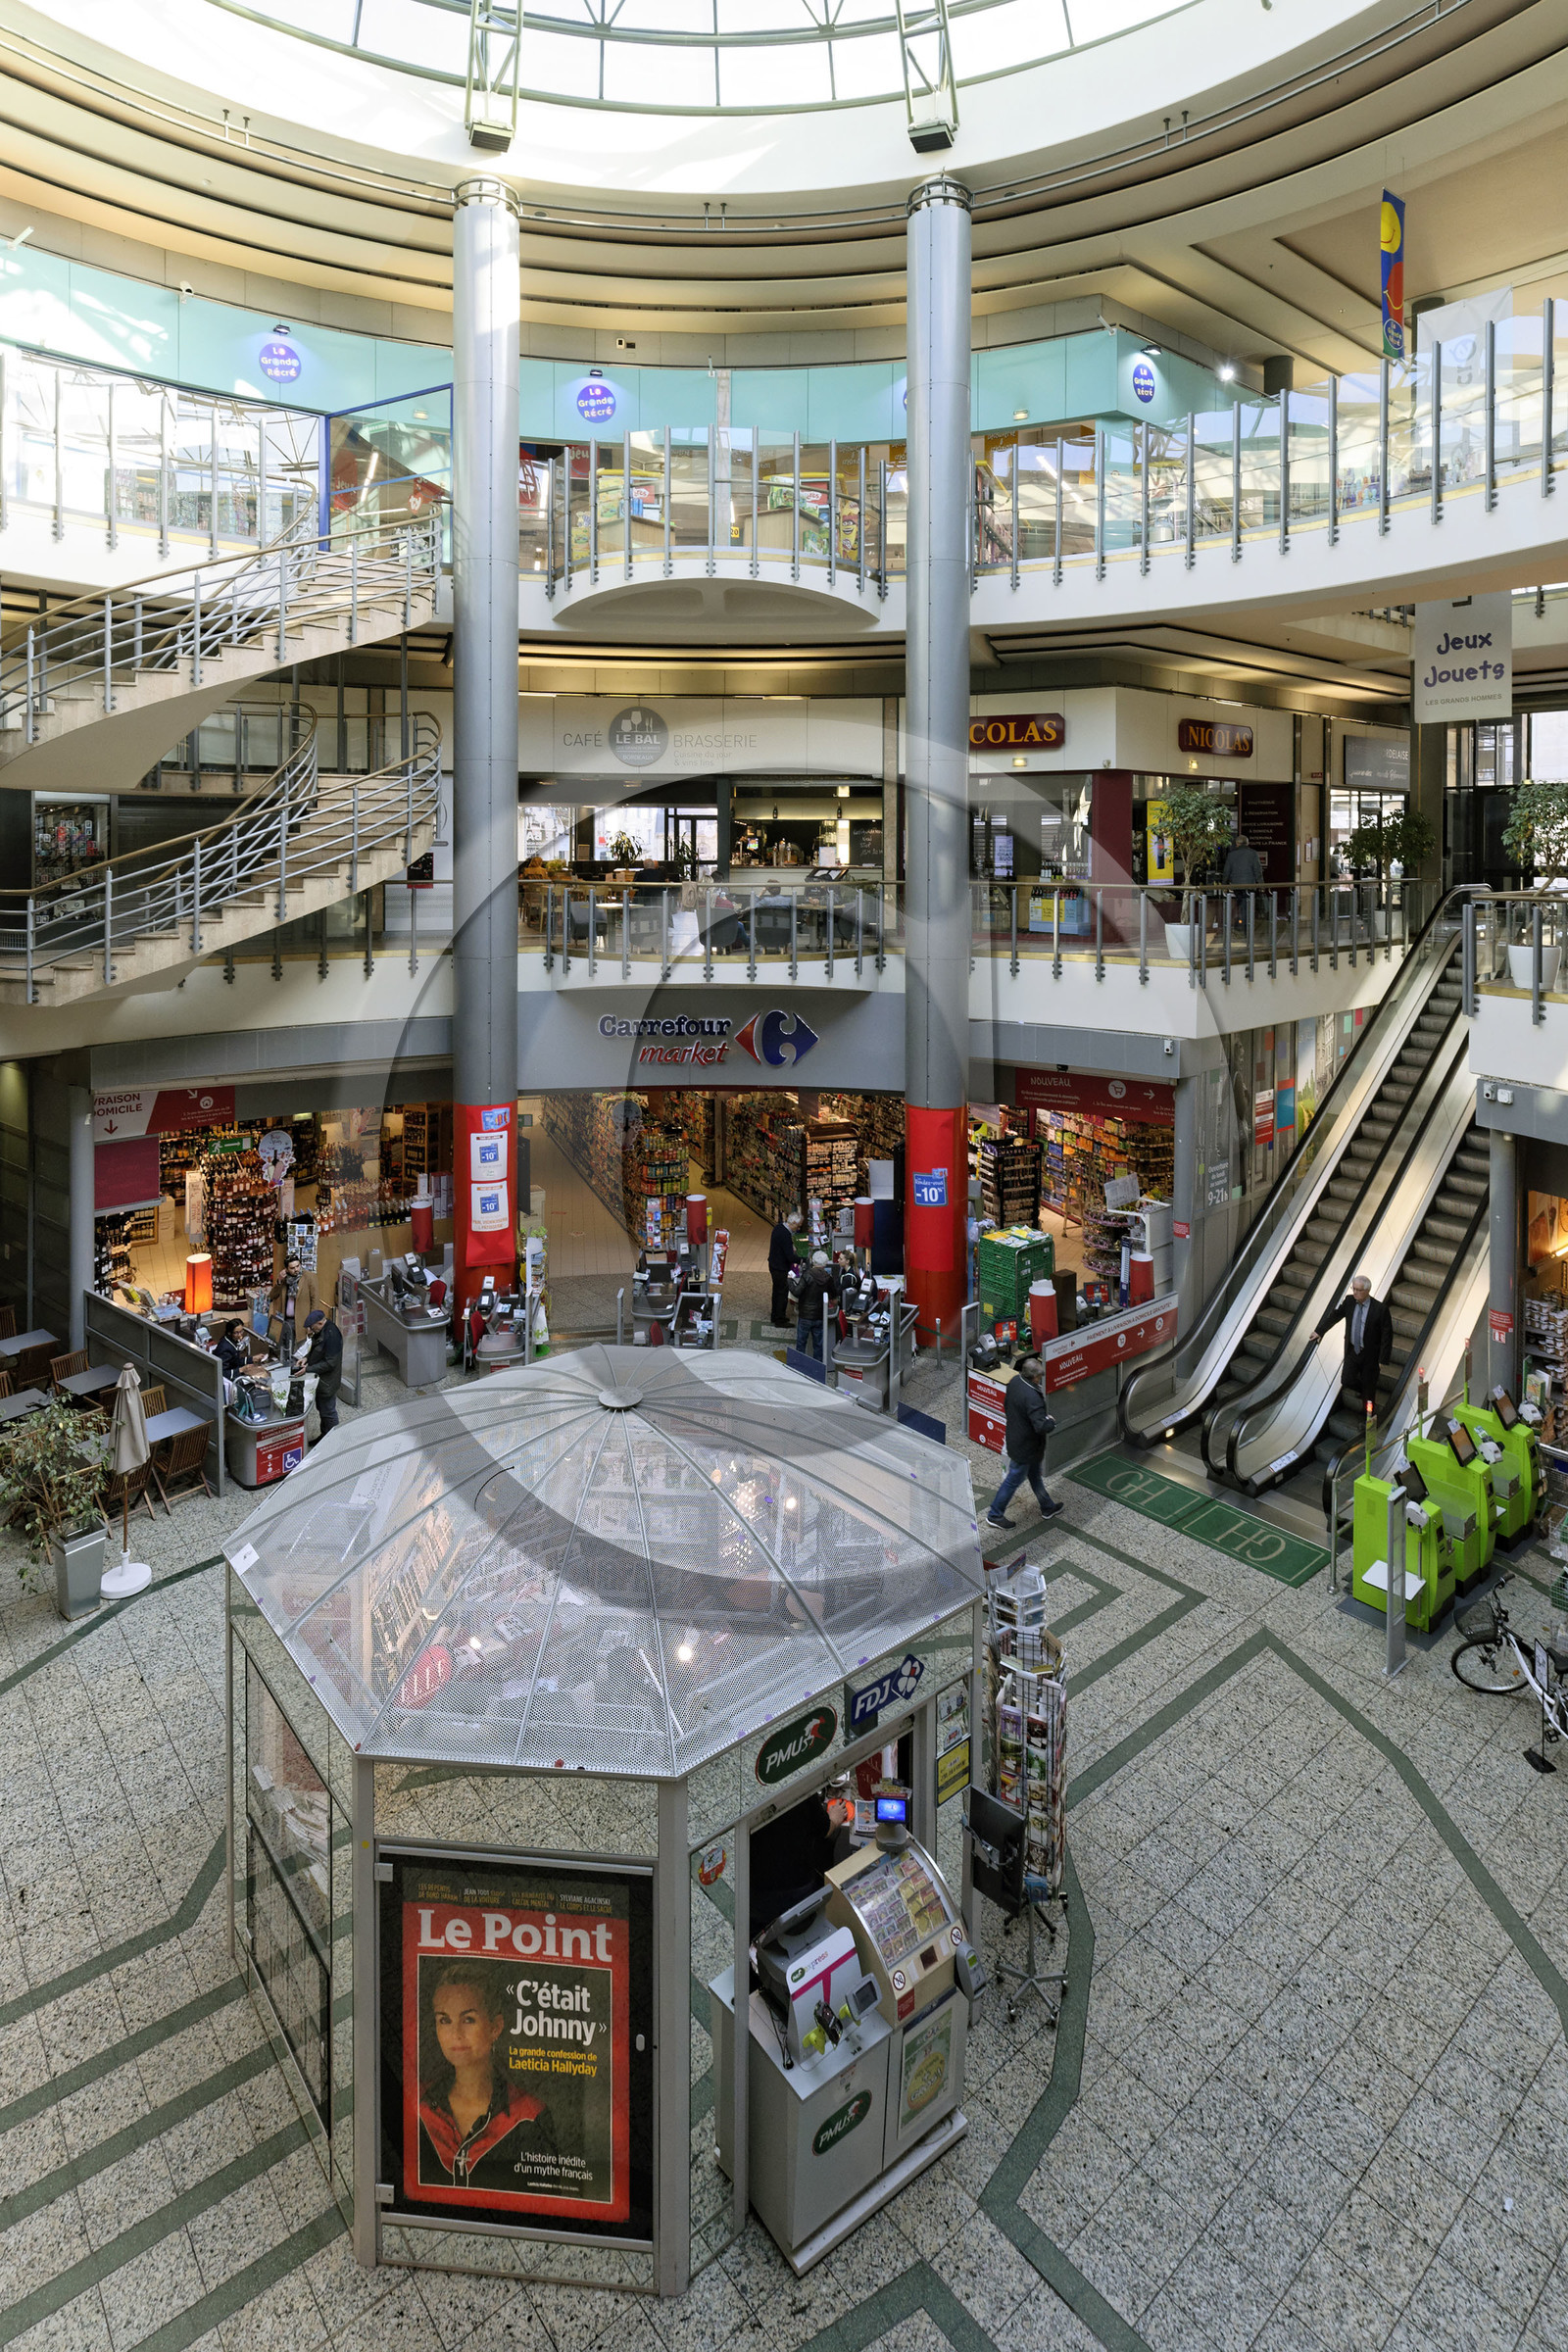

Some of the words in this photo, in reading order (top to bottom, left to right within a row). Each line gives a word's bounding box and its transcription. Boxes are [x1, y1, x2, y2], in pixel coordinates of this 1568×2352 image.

[272, 347, 286, 356] La
[261, 356, 300, 368] Grande
[267, 367, 298, 378] Récré
[589, 387, 602, 396] La
[577, 396, 615, 408] Grande
[584, 406, 612, 418] Récré
[1437, 632, 1493, 655] Jeux
[1424, 661, 1504, 687] Jouets
[563, 731, 603, 747] CAFÉ
[616, 735, 631, 744] LE
[636, 735, 661, 745] BAL
[673, 735, 758, 748] BRASSERIE
[1188, 725, 1250, 752] NICOLAS
[715, 751, 732, 761] jour
[599, 1014, 732, 1037] Carrefour
[639, 1040, 730, 1065] market
[1030, 1077, 1071, 1088] NOUVEAU
[1059, 1353, 1084, 1371] NOUVEAU
[855, 1679, 891, 1719] FDJ
[765, 1738, 803, 1774] PMU
[560, 1894, 583, 1903] SYLVIANE
[584, 1896, 611, 1905] AGACINSKI
[417, 1909, 472, 1948] Le
[482, 1913, 612, 1962] Point
[804, 1951, 829, 1973] express
[509, 2046, 518, 2055] La
[519, 2047, 546, 2058] grande
[547, 2048, 586, 2061] confession
[587, 2052, 598, 2062] de
[509, 2057, 550, 2072] Laeticia
[551, 2060, 598, 2078] Hallyday
[819, 2114, 848, 2148] PMU
[520, 2152, 557, 2164] L’histoire
[558, 2155, 586, 2168] inédite
[514, 2163, 532, 2174] d’un
[534, 2165, 561, 2177] mythe
[562, 2167, 593, 2180] français
